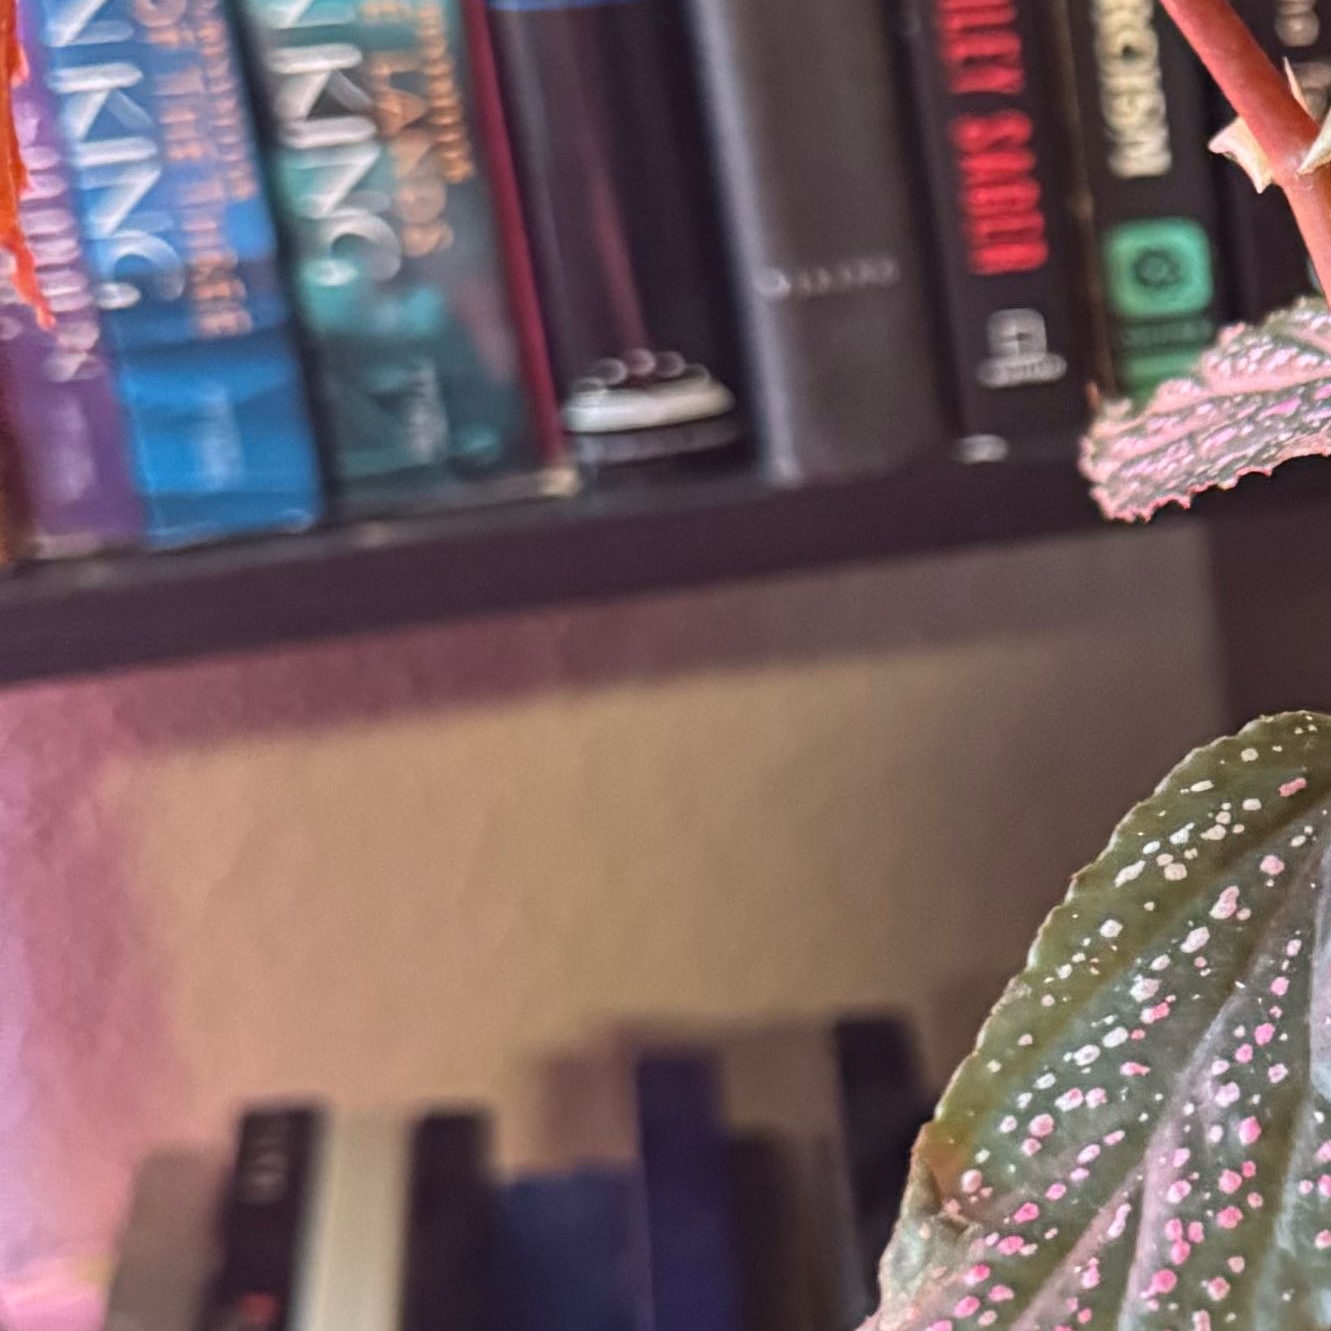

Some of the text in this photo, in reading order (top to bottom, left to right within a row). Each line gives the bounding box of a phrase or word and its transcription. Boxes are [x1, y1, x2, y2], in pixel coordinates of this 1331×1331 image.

[58, 59, 188, 310] KING
[265, 42, 403, 285] KING
[950, 109, 1050, 276] SAGER
